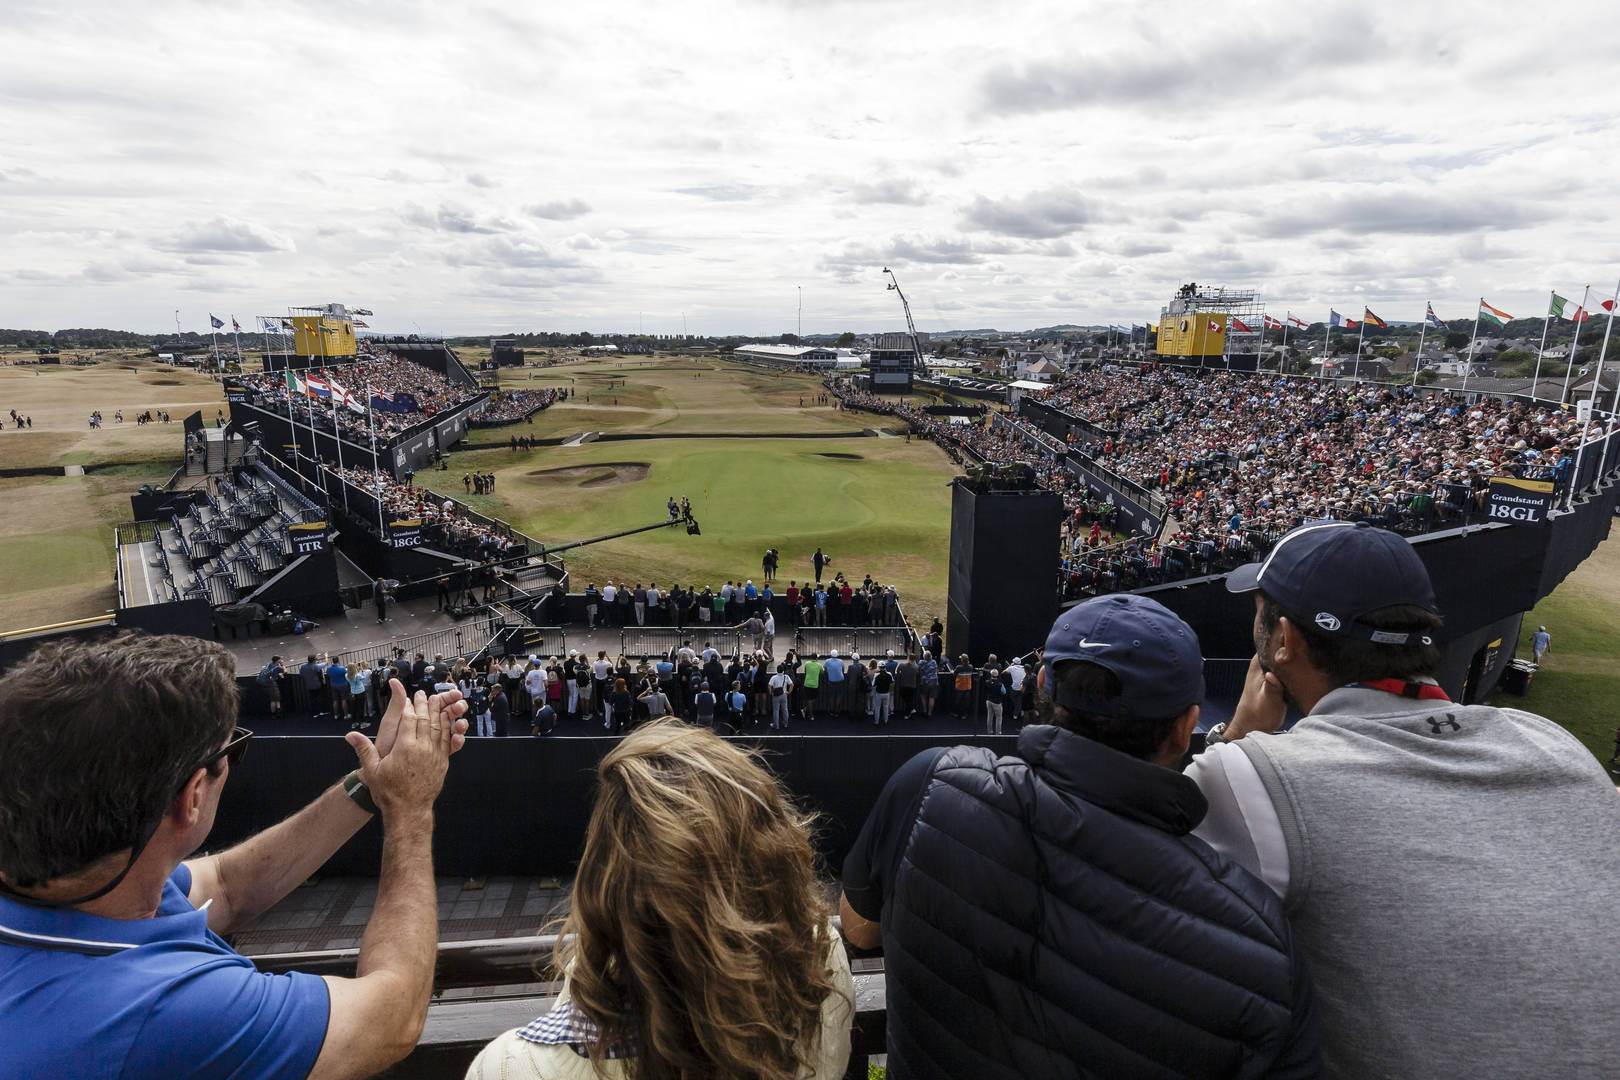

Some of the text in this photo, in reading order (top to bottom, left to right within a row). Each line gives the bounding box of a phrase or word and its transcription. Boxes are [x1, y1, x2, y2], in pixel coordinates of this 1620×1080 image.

[1491, 493, 1544, 506] Grandstand
[1488, 503, 1540, 522] 18GL
[298, 540, 323, 553] 1TR
[393, 535, 421, 548] 18GC
